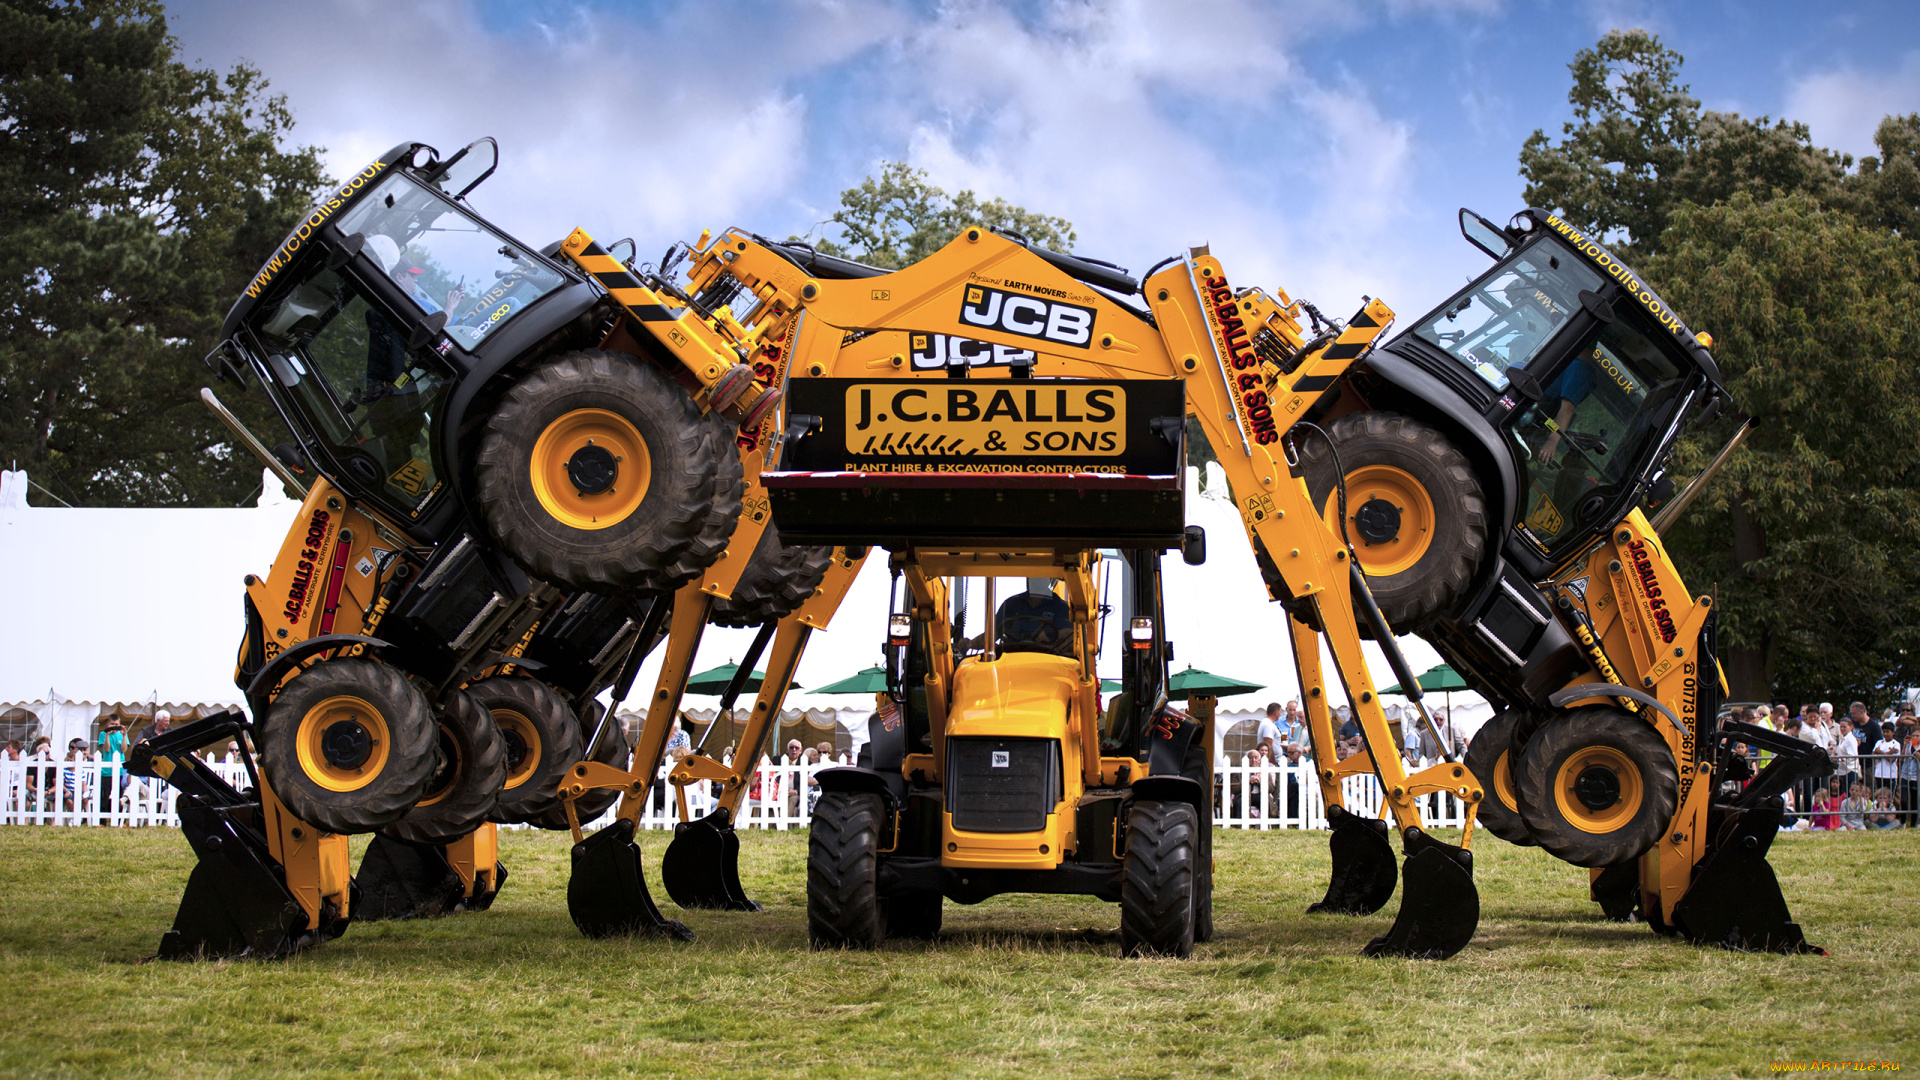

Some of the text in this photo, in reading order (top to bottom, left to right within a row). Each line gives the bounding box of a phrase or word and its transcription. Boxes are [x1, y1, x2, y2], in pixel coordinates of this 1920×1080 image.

[1004, 279, 1032, 291] EARTH
[1033, 285, 1067, 299] MOVERS
[964, 291, 1092, 345] JCB
[759, 344, 782, 362] &
[914, 334, 1035, 368] JCB
[1206, 275, 1279, 446] J.C.BALLS & SONS
[759, 425, 770, 446] PLANT
[774, 351, 789, 389] XCAVATION
[855, 389, 1116, 431] J.C.BALLS
[1230, 381, 1252, 437] CONTRACTORS
[983, 430, 1117, 452] & SONS
[393, 458, 429, 494] JCB
[845, 463, 1128, 475] PLANT HIRE & EXCAVATION CONTRACTORS
[1533, 500, 1561, 533] JCB
[283, 508, 331, 624] J.C.BALLS & SONS
[302, 522, 336, 619] OF AMBERGATE DERBYSHIRE
[1627, 539, 1662, 599] J.C.BALLS
[1623, 550, 1631, 560] OF
[1627, 561, 1646, 600] AMBERGATE
[1642, 601, 1661, 642] DERBYSHIRE
[1649, 598, 1667, 611] &
[1653, 609, 1678, 645] SONS
[1575, 624, 1639, 713] NO PROBEM
[1683, 677, 1696, 714] 01773
[1681, 765, 1694, 775] &
